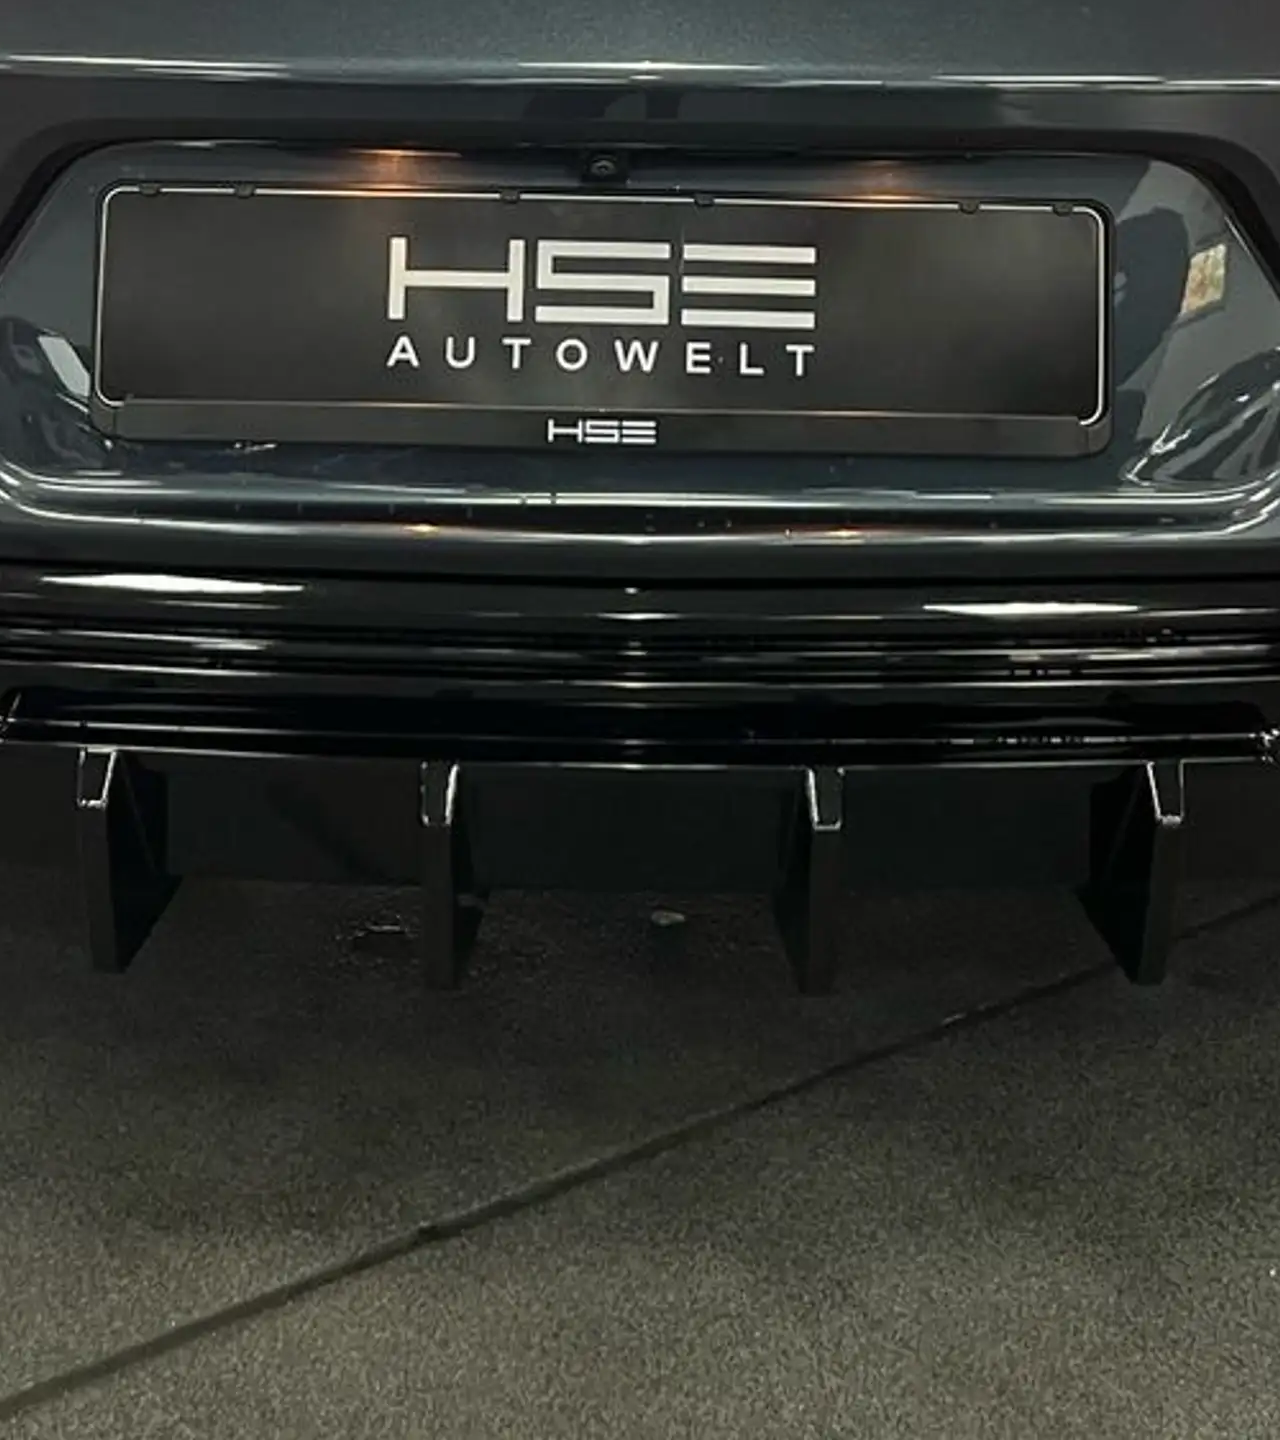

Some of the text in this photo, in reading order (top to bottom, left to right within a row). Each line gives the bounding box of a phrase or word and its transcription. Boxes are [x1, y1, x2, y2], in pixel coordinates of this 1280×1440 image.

[386, 235, 817, 330] HSE
[385, 334, 816, 378] AUTOWELT
[546, 417, 658, 446] HSE
